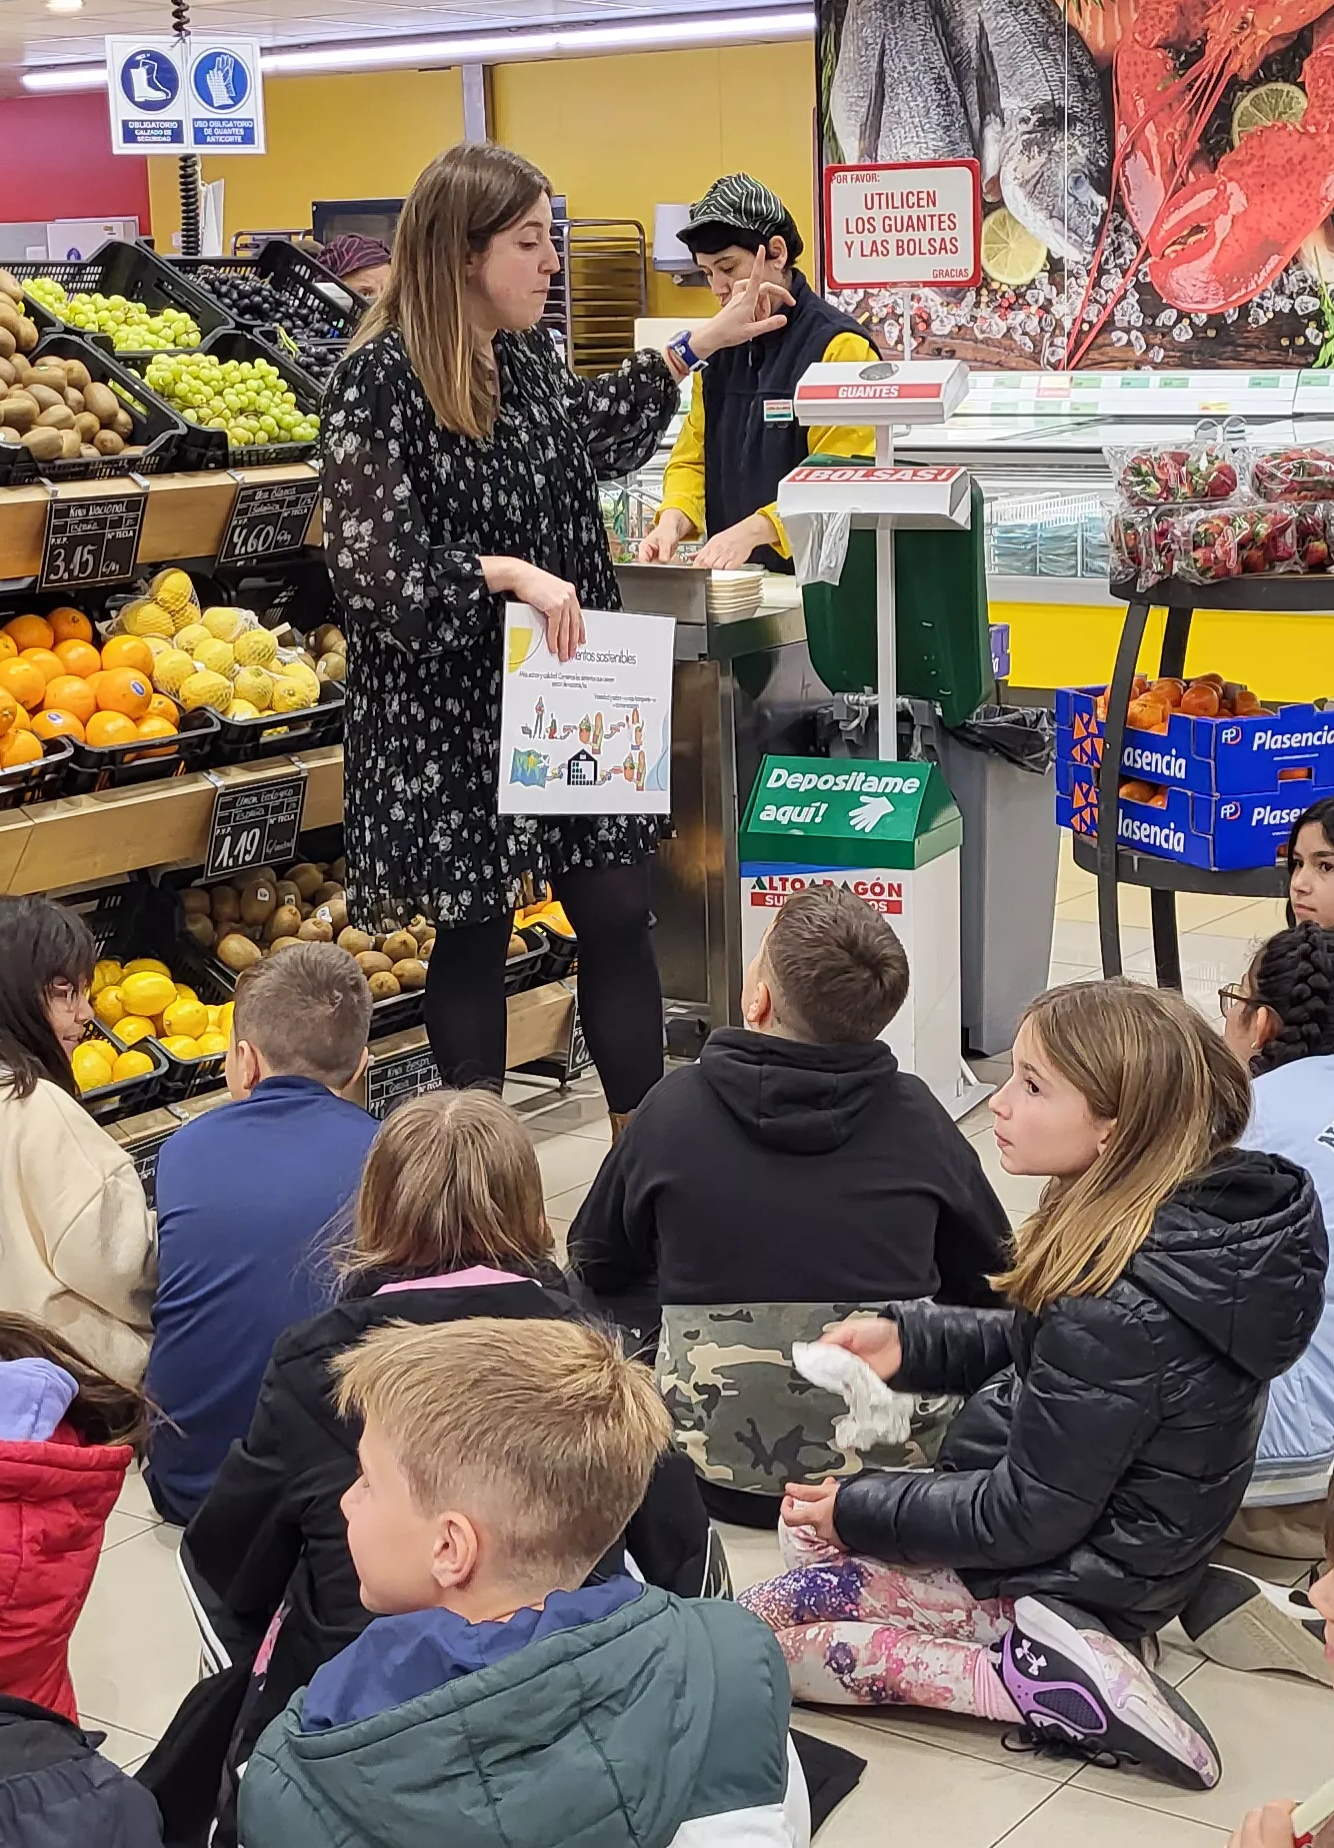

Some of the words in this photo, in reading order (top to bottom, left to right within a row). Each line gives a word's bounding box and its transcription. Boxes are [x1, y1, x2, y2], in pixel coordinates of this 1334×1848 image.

[831, 173, 848, 184] POR
[850, 173, 880, 184] FAVOR:
[864, 190, 937, 211] UTILICEN
[845, 216, 877, 235] LOS
[882, 213, 957, 234] GUANTES
[844, 240, 855, 259] Y
[860, 239, 890, 258] LAS
[895, 236, 959, 257] BOLSAS
[932, 268, 969, 279] GRACIAS
[838, 385, 900, 398] GUANTES
[116, 530, 134, 538] TECLA
[1122, 746, 1186, 780] asencia
[277, 813, 295, 823] TECLA
[759, 801, 829, 825] aquí!
[1251, 805, 1304, 827] Plase
[1117, 808, 1185, 854] lasencia
